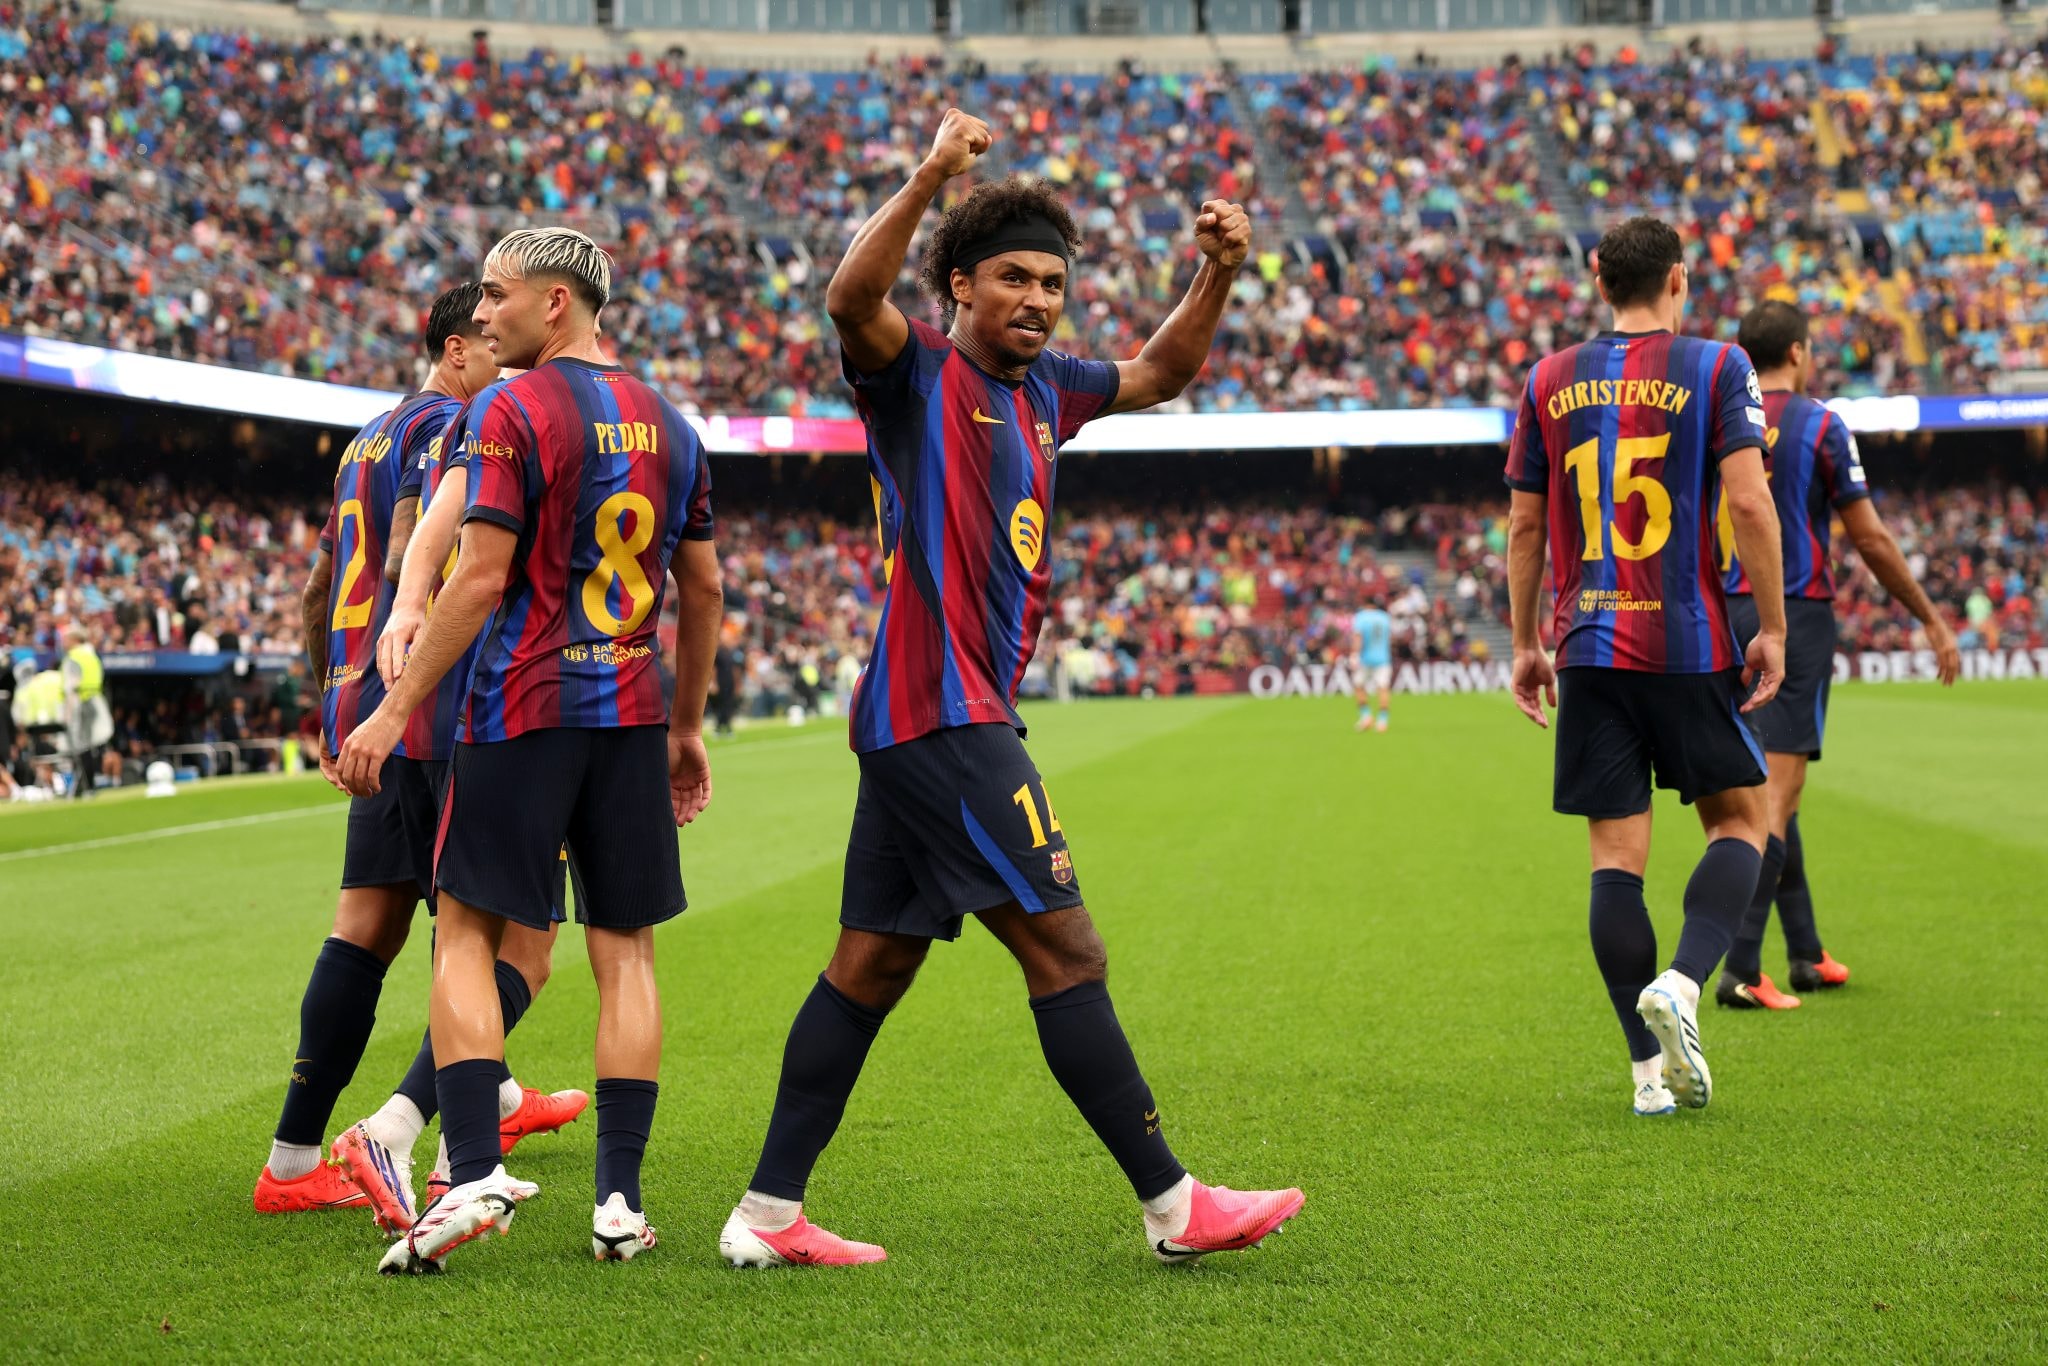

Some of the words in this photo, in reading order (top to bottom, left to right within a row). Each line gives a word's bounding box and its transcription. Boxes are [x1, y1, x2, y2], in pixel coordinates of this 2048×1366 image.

[1548, 379, 1692, 420] CHRISTENSEN
[464, 430, 514, 460] Midea
[593, 421, 657, 454] PEDRI
[1564, 431, 1673, 561] 15
[332, 499, 374, 632] 2
[581, 491, 656, 637] 8
[1597, 600, 1662, 611] FOUNDATION
[1598, 590, 1633, 602] BARÇA
